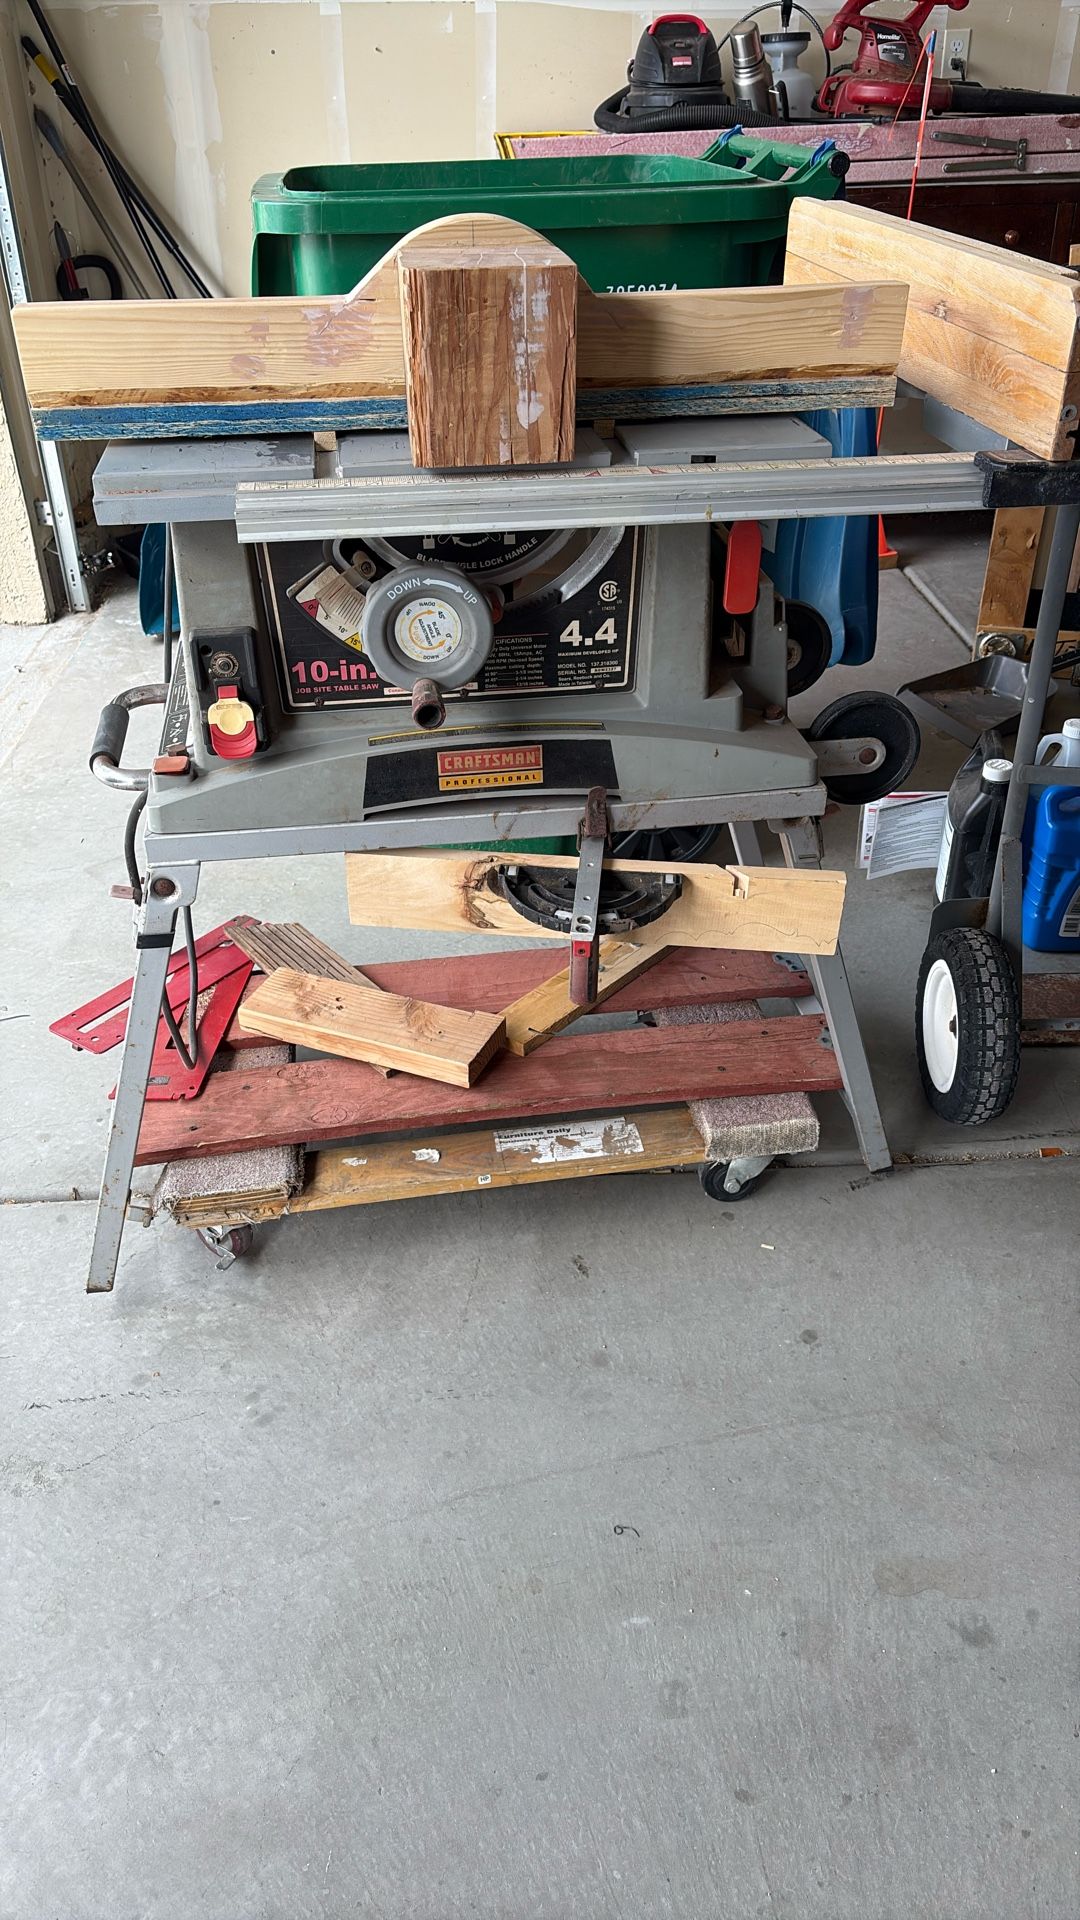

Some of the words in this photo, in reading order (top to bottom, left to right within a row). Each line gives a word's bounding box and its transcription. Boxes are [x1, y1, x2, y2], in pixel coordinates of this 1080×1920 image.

[416, 553, 446, 564] BLA
[480, 558, 503, 568] LOCK
[505, 537, 538, 560] HANDLE
[386, 578, 421, 600] DOWN
[463, 590, 478, 604] UP
[418, 619, 432, 646] ADJUSTMENT
[432, 622, 441, 636] BLADE
[560, 618, 617, 646] 4.4
[350, 637, 361, 646] 15°
[292, 660, 377, 683] 10-in.
[444, 752, 535, 769] CRAFTSMAN
[446, 774, 536, 786] PROFESSIONAL
